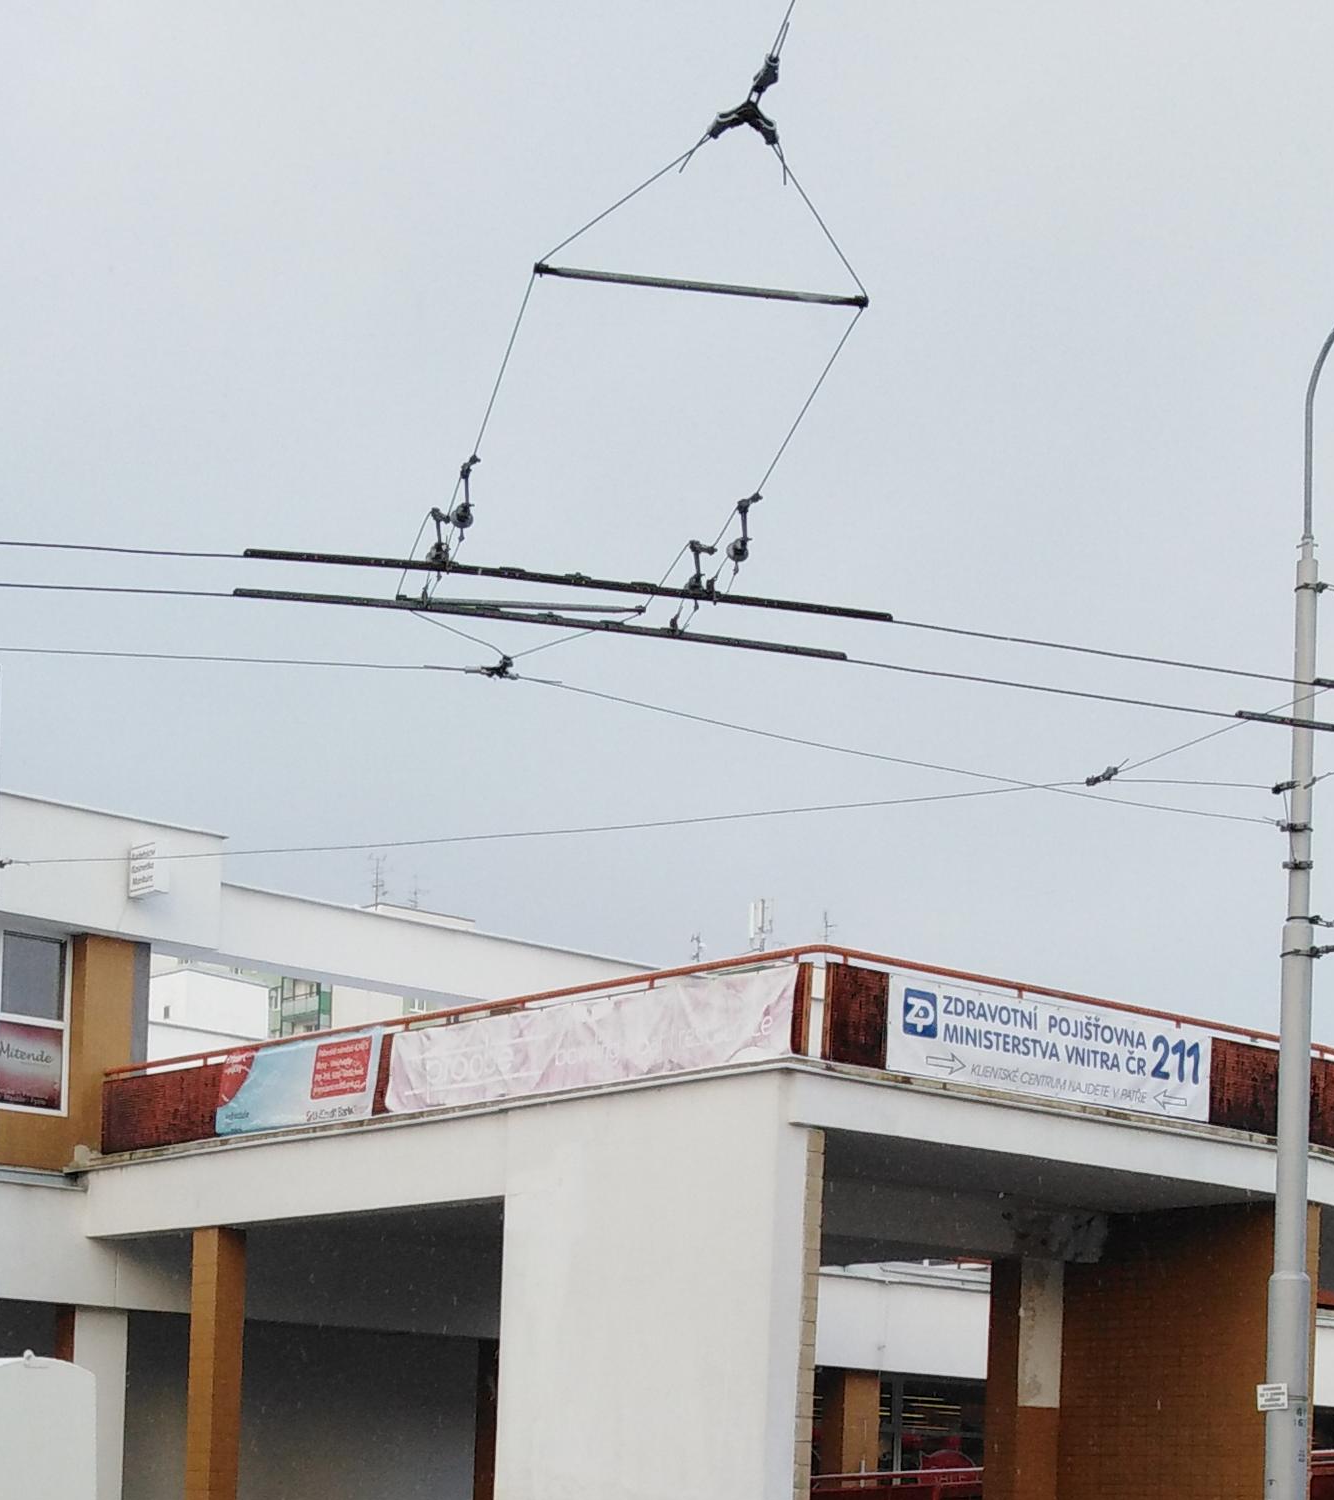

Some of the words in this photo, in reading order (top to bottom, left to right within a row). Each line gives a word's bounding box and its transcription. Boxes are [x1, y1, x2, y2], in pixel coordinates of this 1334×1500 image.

[943, 995, 1038, 1031] ZDRAVOTNÍ
[1048, 1015, 1147, 1050] POJIŠŤOVNA
[943, 1023, 1060, 1062] MINISTERSTVA
[1065, 1044, 1120, 1072] VNITRA
[1125, 1049, 1147, 1076] ČR
[1151, 1034, 1201, 1085] 211
[971, 1063, 1019, 1083] KLIENTSKÉ
[1020, 1072, 1067, 1091] CENTRUM
[1068, 1079, 1110, 1098] NAJDETE
